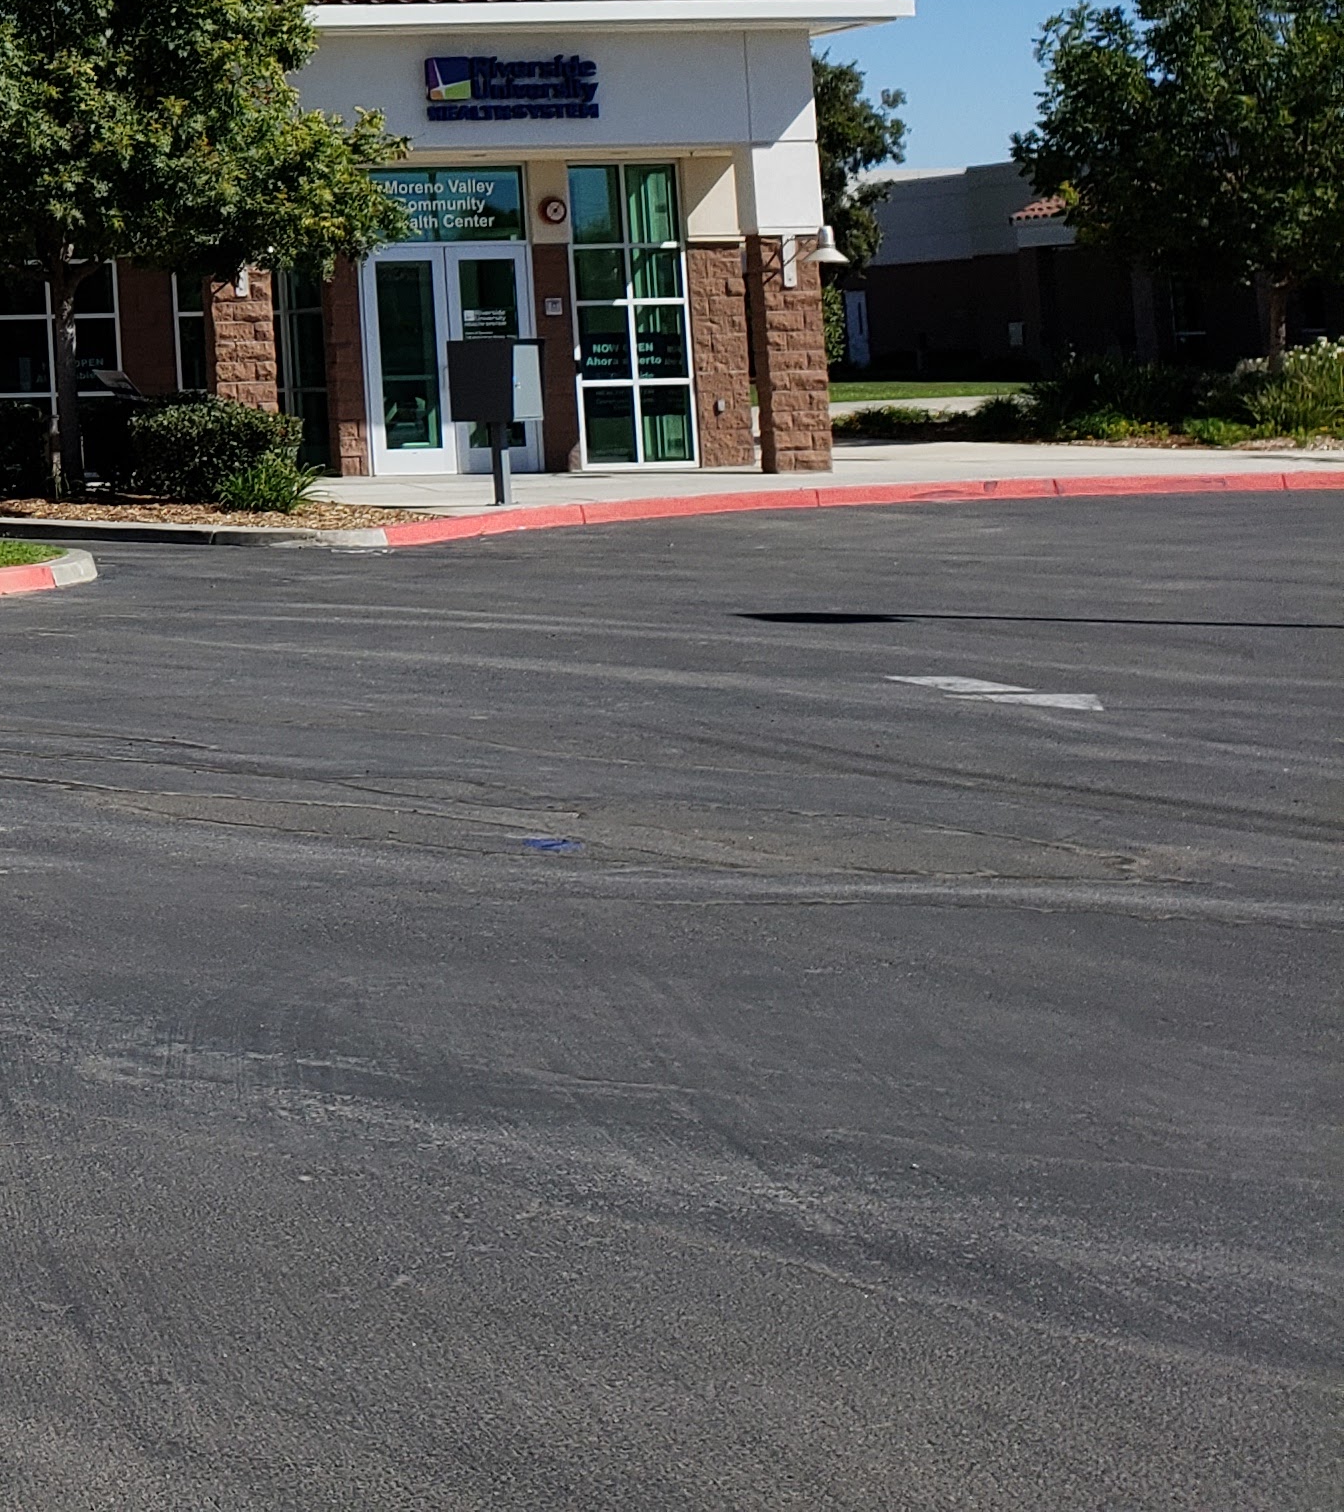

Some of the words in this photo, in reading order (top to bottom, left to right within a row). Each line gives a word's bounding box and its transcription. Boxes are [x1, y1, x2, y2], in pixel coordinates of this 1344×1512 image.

[384, 180, 444, 195] Moreno
[448, 179, 495, 196] Valley
[407, 196, 486, 214] ommunity
[409, 215, 438, 229] alth
[442, 214, 495, 228] Center
